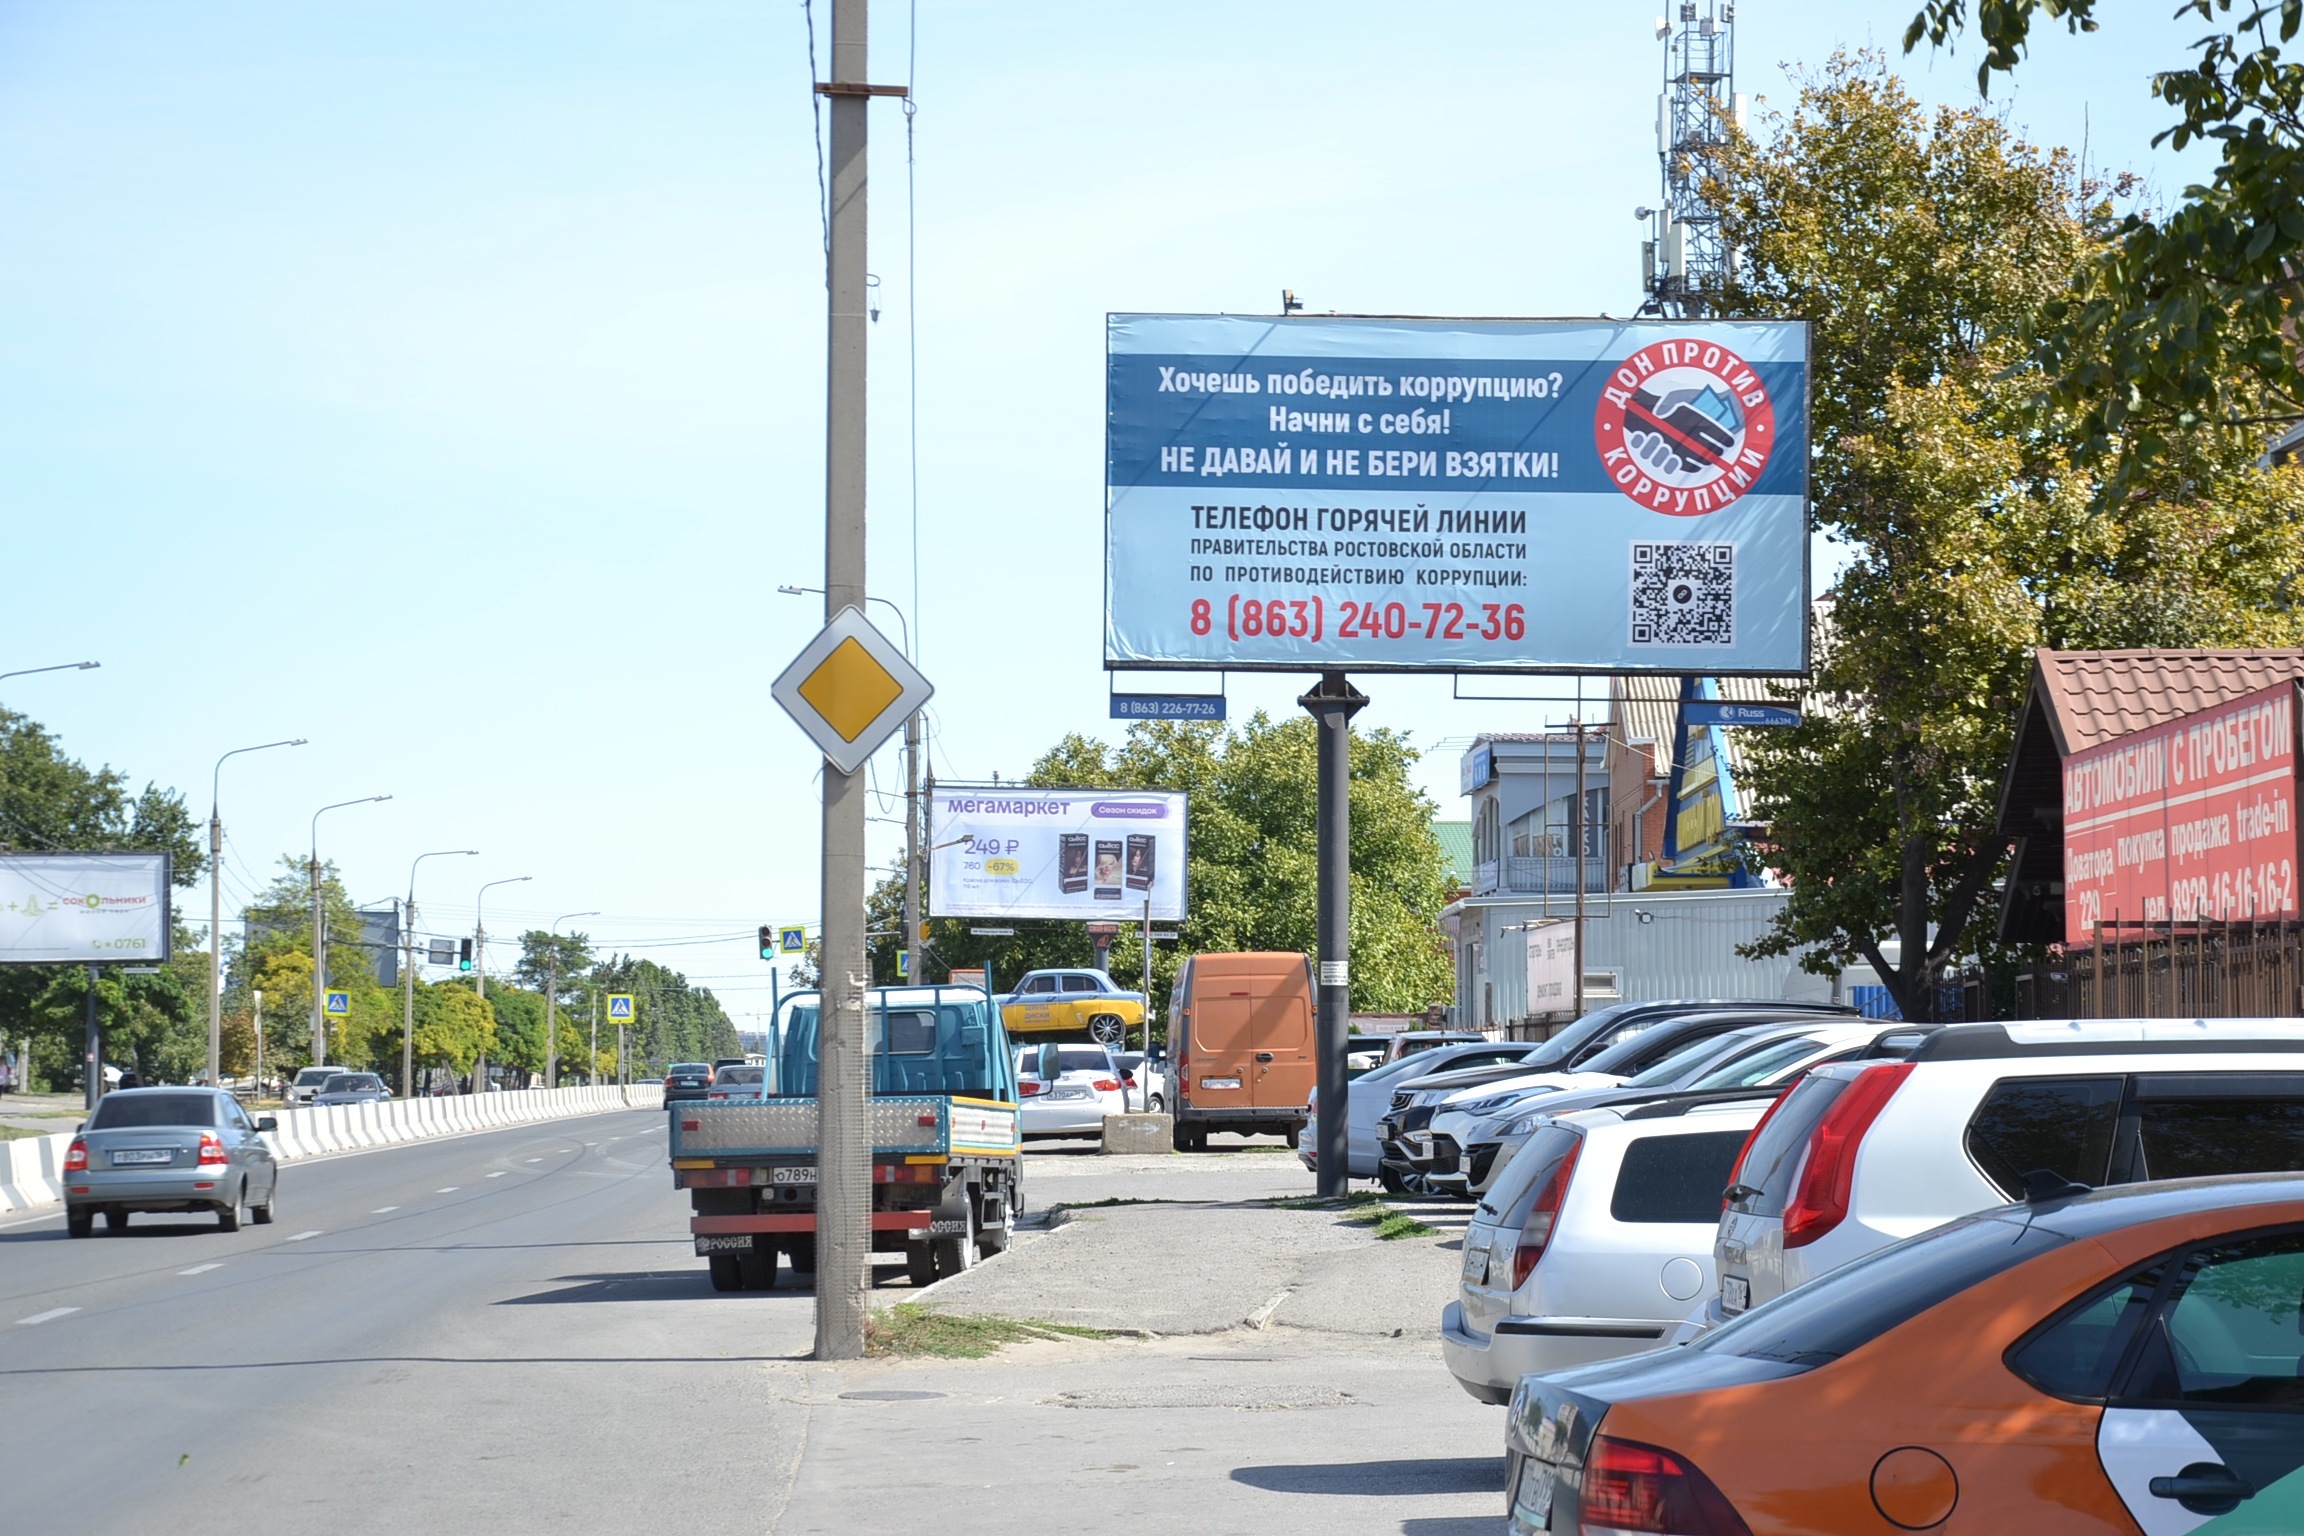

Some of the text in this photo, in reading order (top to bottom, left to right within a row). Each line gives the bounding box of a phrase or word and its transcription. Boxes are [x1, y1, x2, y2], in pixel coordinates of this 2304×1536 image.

[1158, 366, 1564, 403] Хочешь победить коррупцию?
[1604, 342, 1765, 410] ДОН ПРОТИВ
[1269, 406, 1451, 435] Начни с себя!
[1160, 441, 1559, 478] НЕ ДАВАЙ И НЕ БЕРИ ВЗЯТКИ!
[1604, 446, 1765, 512] КОРРУПЦИИ
[1191, 503, 1526, 534] ТЕЛЕФОН ГОРЯЧЕЙ ЛИНИИ
[1190, 538, 1526, 560] ПРАВИТЕЛЬСТВА РОСТОВСКОЙ ОБЛАСТИ
[1190, 564, 1527, 588] ПО ПРОТИВОДЕЙСТВИЮ КОРРУПЦИИ:
[1190, 593, 1526, 643] 8 (863) 240-72-36
[1120, 701, 1216, 714] 8 (863) 226-77-26
[1738, 708, 1765, 717] Russ
[2065, 694, 2292, 815] АВТОМОБИЛИ С ПРОБЕГОМ
[948, 799, 1070, 817] мегамаркет
[1099, 805, 1158, 815] Сезон скидок
[2118, 789, 2289, 873] покупка продажа trade-in
[964, 838, 1000, 855] 249
[2066, 846, 2114, 891] Доватора
[2080, 890, 2100, 931] 229
[923, 1219, 967, 1234] ОССИЯ
[711, 1235, 753, 1250] РОССИЯ
